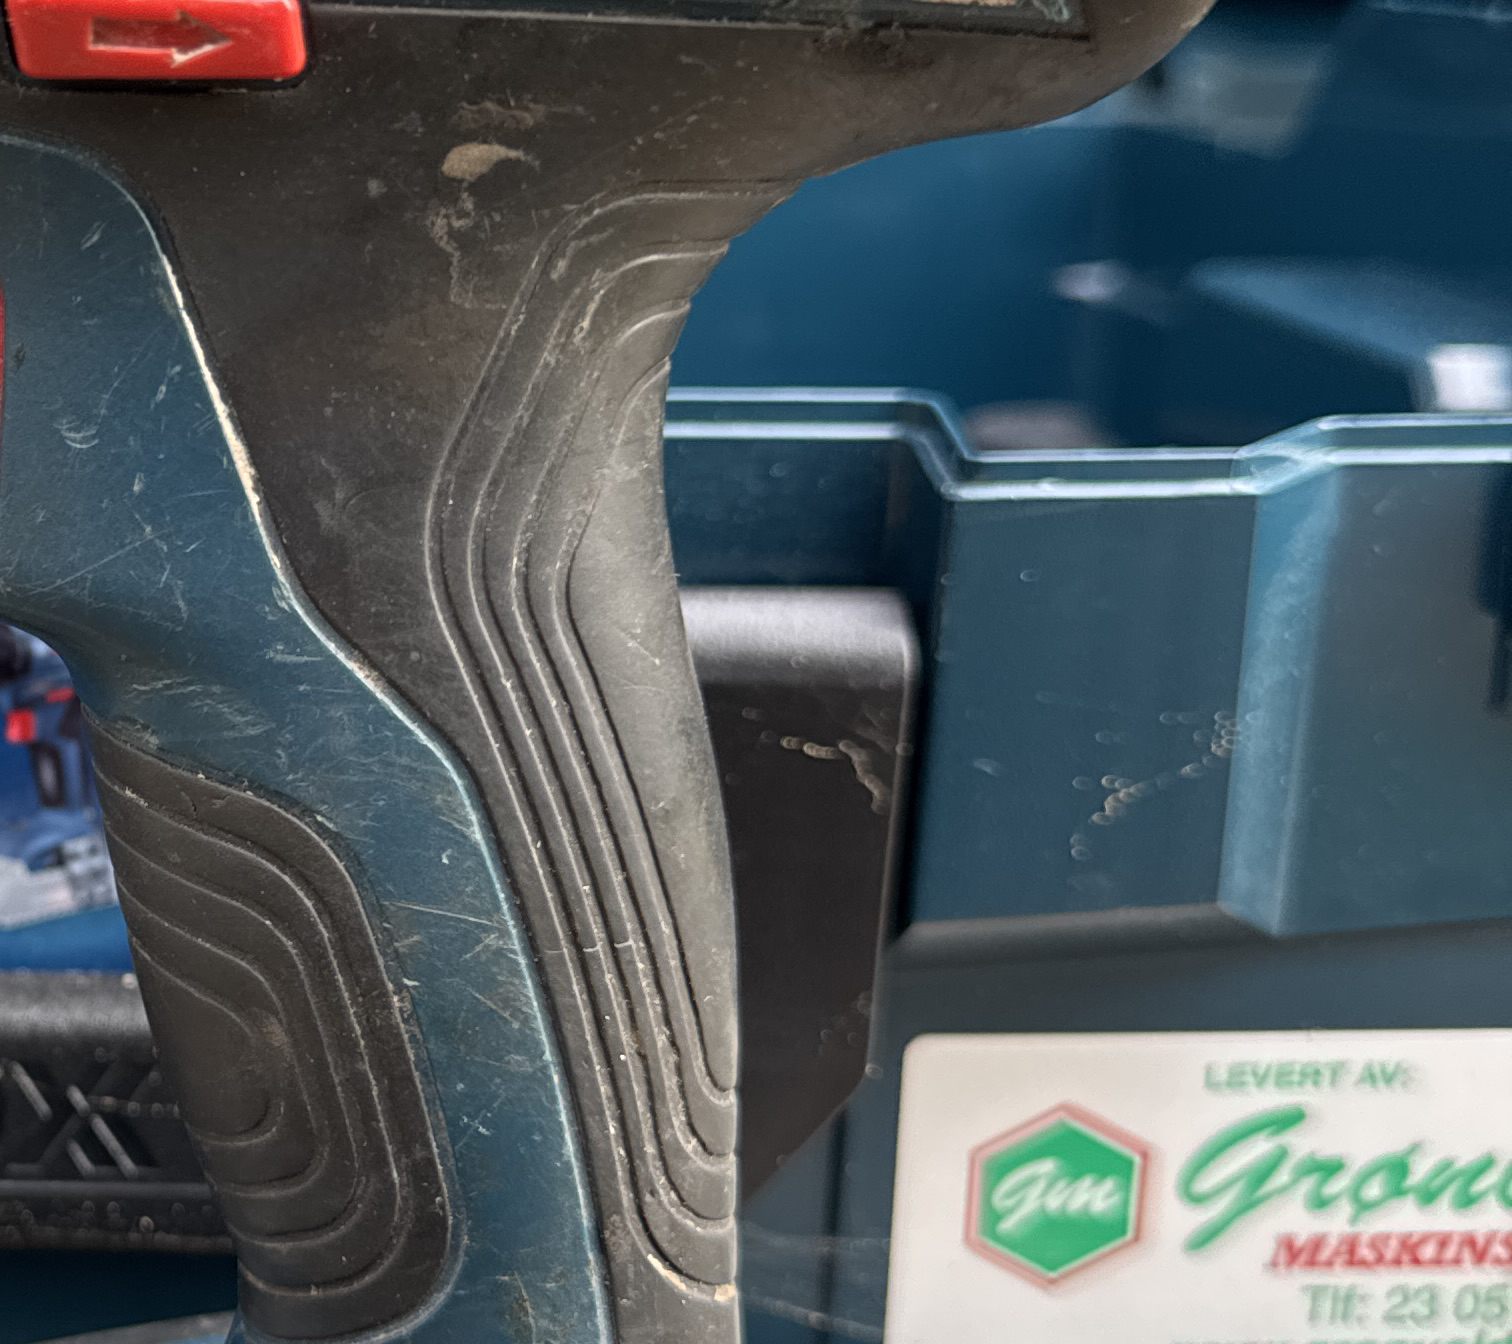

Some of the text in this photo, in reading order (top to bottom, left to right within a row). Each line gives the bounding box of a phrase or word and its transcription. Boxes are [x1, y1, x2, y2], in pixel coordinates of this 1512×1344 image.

[1203, 1060, 1346, 1089] LEVERT
[1301, 1283, 1509, 1327] Tlf: 23 05
